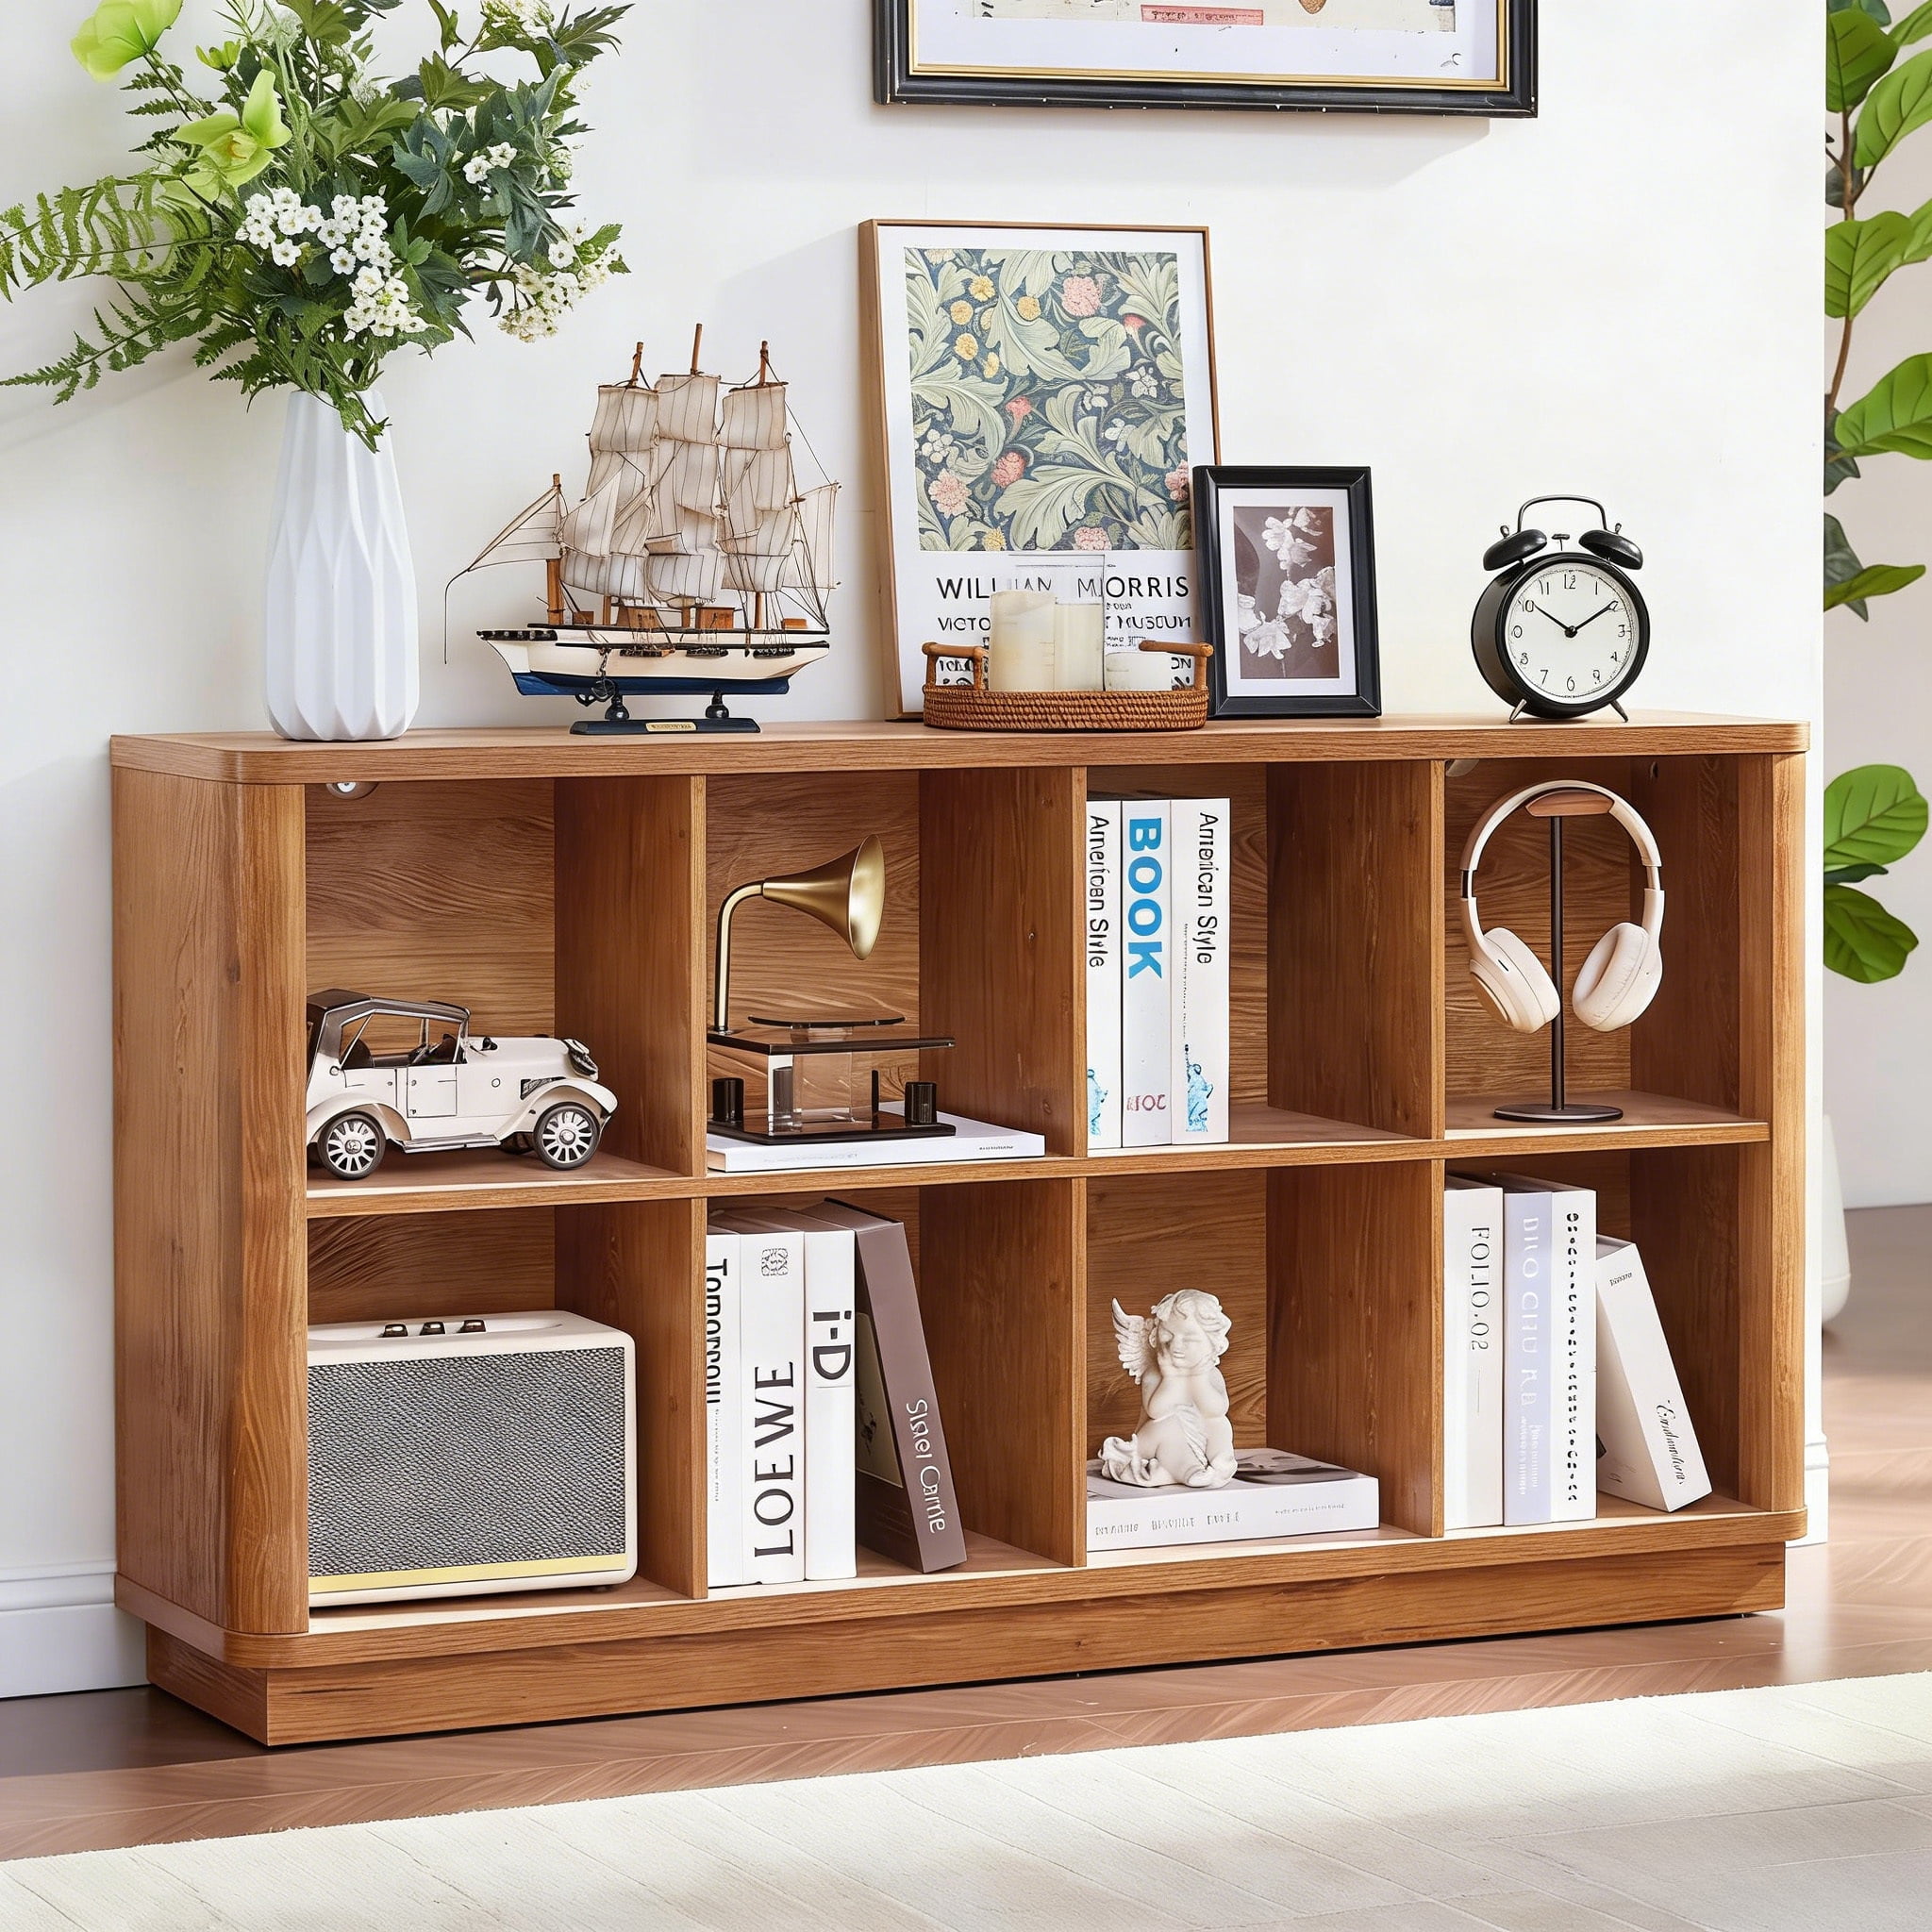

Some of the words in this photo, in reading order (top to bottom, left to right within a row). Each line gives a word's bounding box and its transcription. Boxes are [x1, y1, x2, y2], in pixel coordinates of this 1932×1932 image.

[1617, 624, 1625, 638] 3
[1540, 669, 1549, 685] 7
[1566, 675, 1575, 691] 6
[1127, 817, 1163, 979] BOOK
[812, 1309, 852, 1381] i-D
[754, 1361, 794, 1557] LOEWE
